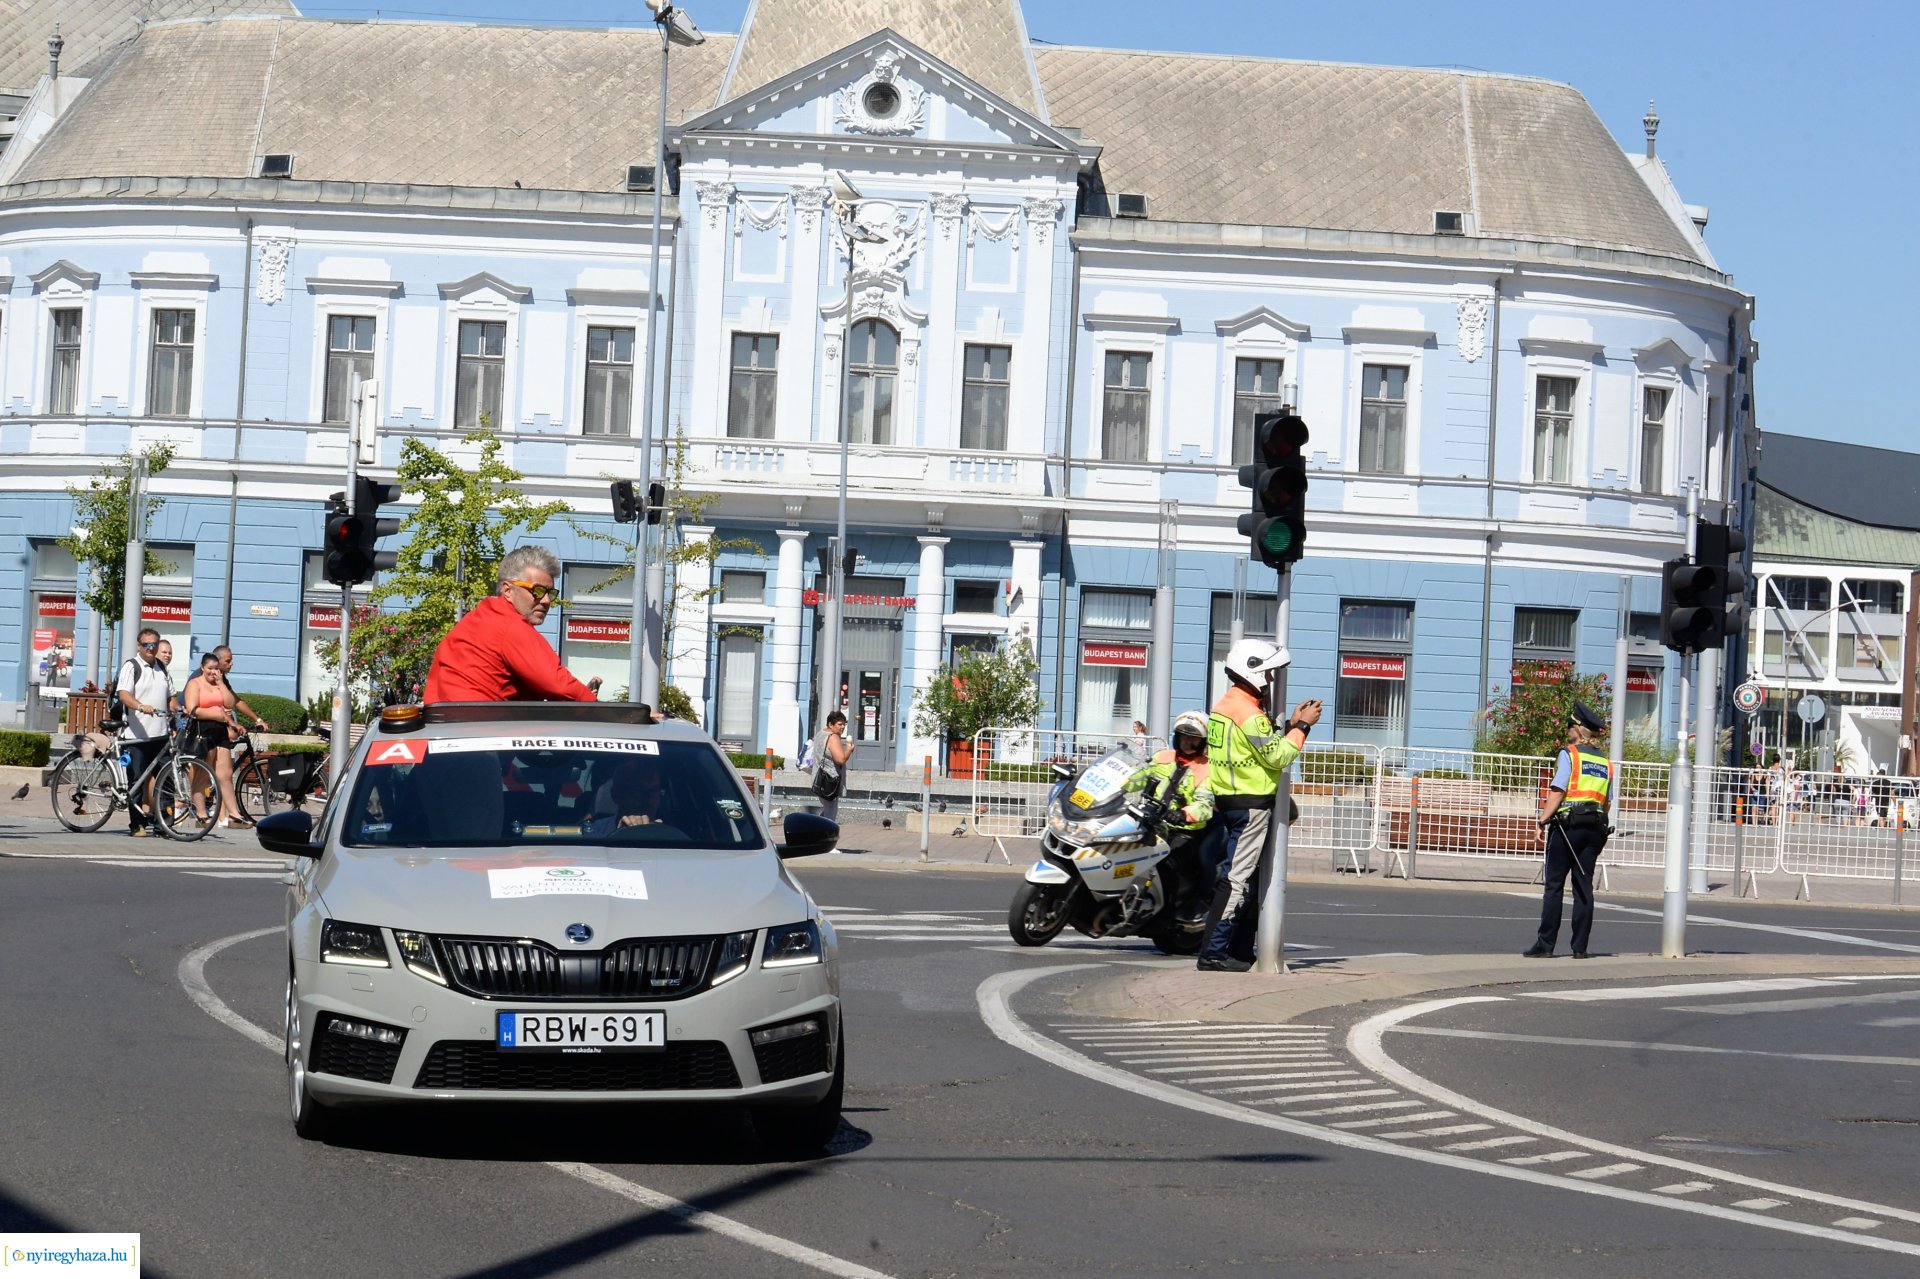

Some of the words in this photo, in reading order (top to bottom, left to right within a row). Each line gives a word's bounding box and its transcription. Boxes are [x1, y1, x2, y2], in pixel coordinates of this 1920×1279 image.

[39, 601, 66, 610] BUDAPEST
[884, 596, 916, 606] BANK
[170, 607, 191, 615] BANK
[568, 625, 607, 634] BUDAPEST
[608, 627, 629, 635] BANK
[1084, 649, 1123, 659] BUDAPEST
[1124, 651, 1146, 660] BANK
[1343, 661, 1382, 671] BUDAPEST
[1382, 663, 1404, 672] BANK
[511, 739, 558, 748] RACE
[563, 739, 648, 752] DIRECTOR
[376, 743, 415, 761] A
[1085, 772, 1112, 792] RACE
[503, 1031, 512, 1042] H
[522, 1016, 654, 1043] RBW-691
